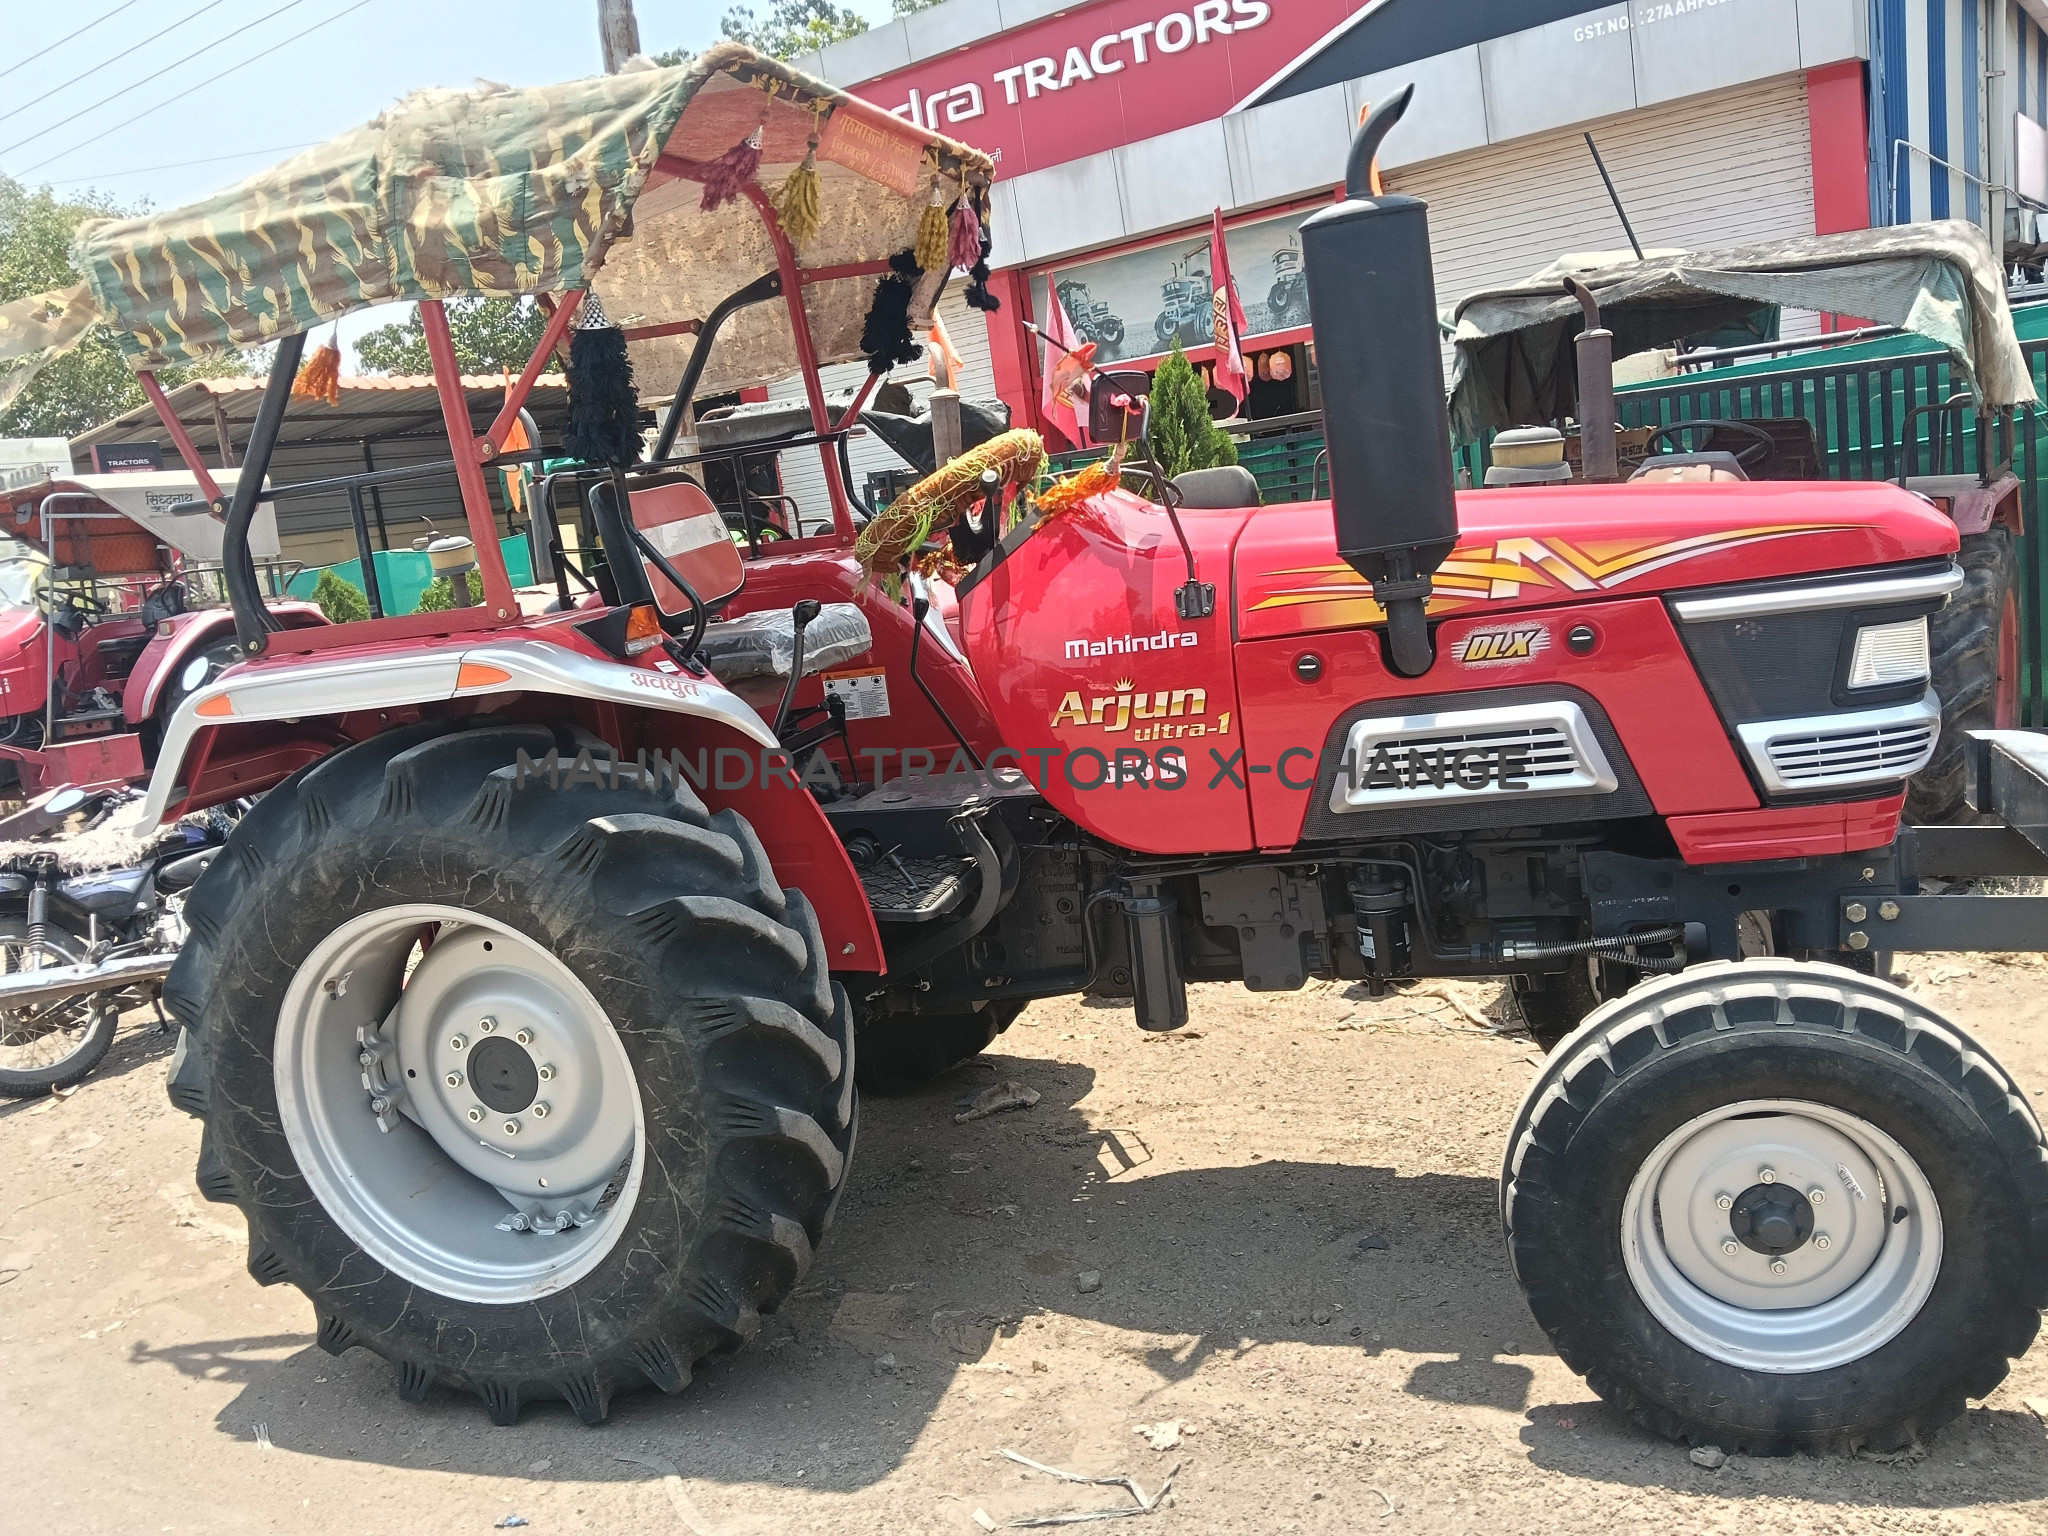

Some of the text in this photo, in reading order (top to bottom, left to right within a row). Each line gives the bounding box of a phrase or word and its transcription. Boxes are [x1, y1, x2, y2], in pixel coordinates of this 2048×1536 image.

[890, 0, 1271, 130] dra TRACTORS
[107, 458, 150, 467] TRACTORS
[1462, 627, 1542, 664] DLX
[1050, 676, 1207, 732] Arjun
[1134, 712, 1231, 742] ultra-1
